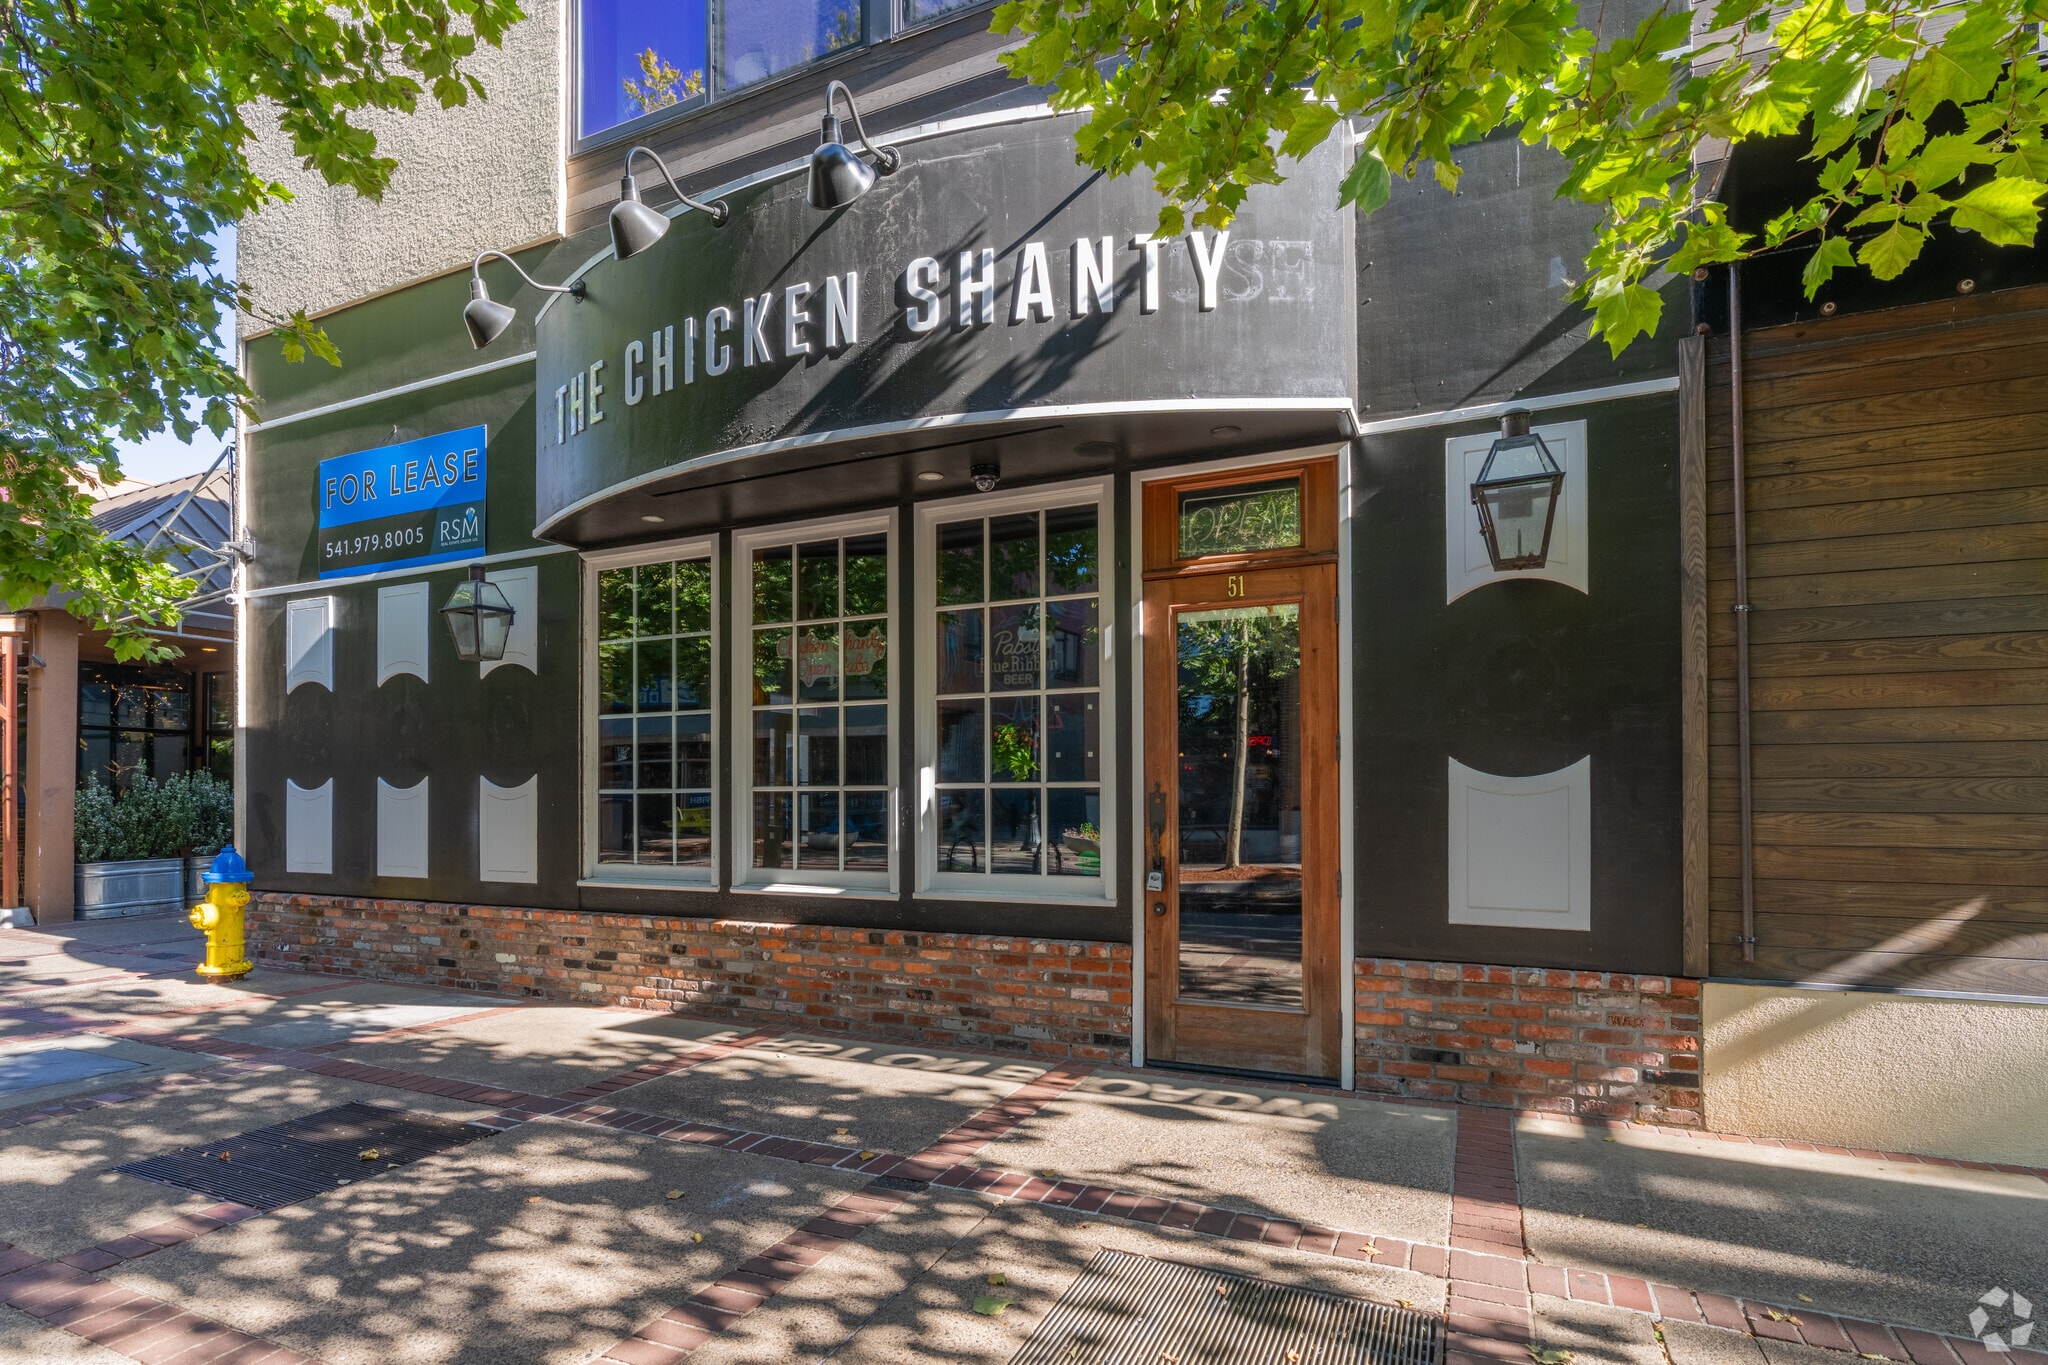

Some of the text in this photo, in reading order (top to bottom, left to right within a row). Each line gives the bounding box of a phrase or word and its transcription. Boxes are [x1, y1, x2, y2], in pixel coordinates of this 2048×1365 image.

[555, 231, 1230, 445] THE CHICKEN SHANTY
[326, 448, 478, 509] FOR LEASE
[441, 516, 479, 541] RSM
[1189, 497, 1291, 542] OPEN
[326, 527, 424, 558] 541.979.8005
[1228, 575, 1245, 597] 51
[1010, 655, 1058, 673] Ribbn
[1004, 673, 1033, 685] BEER
